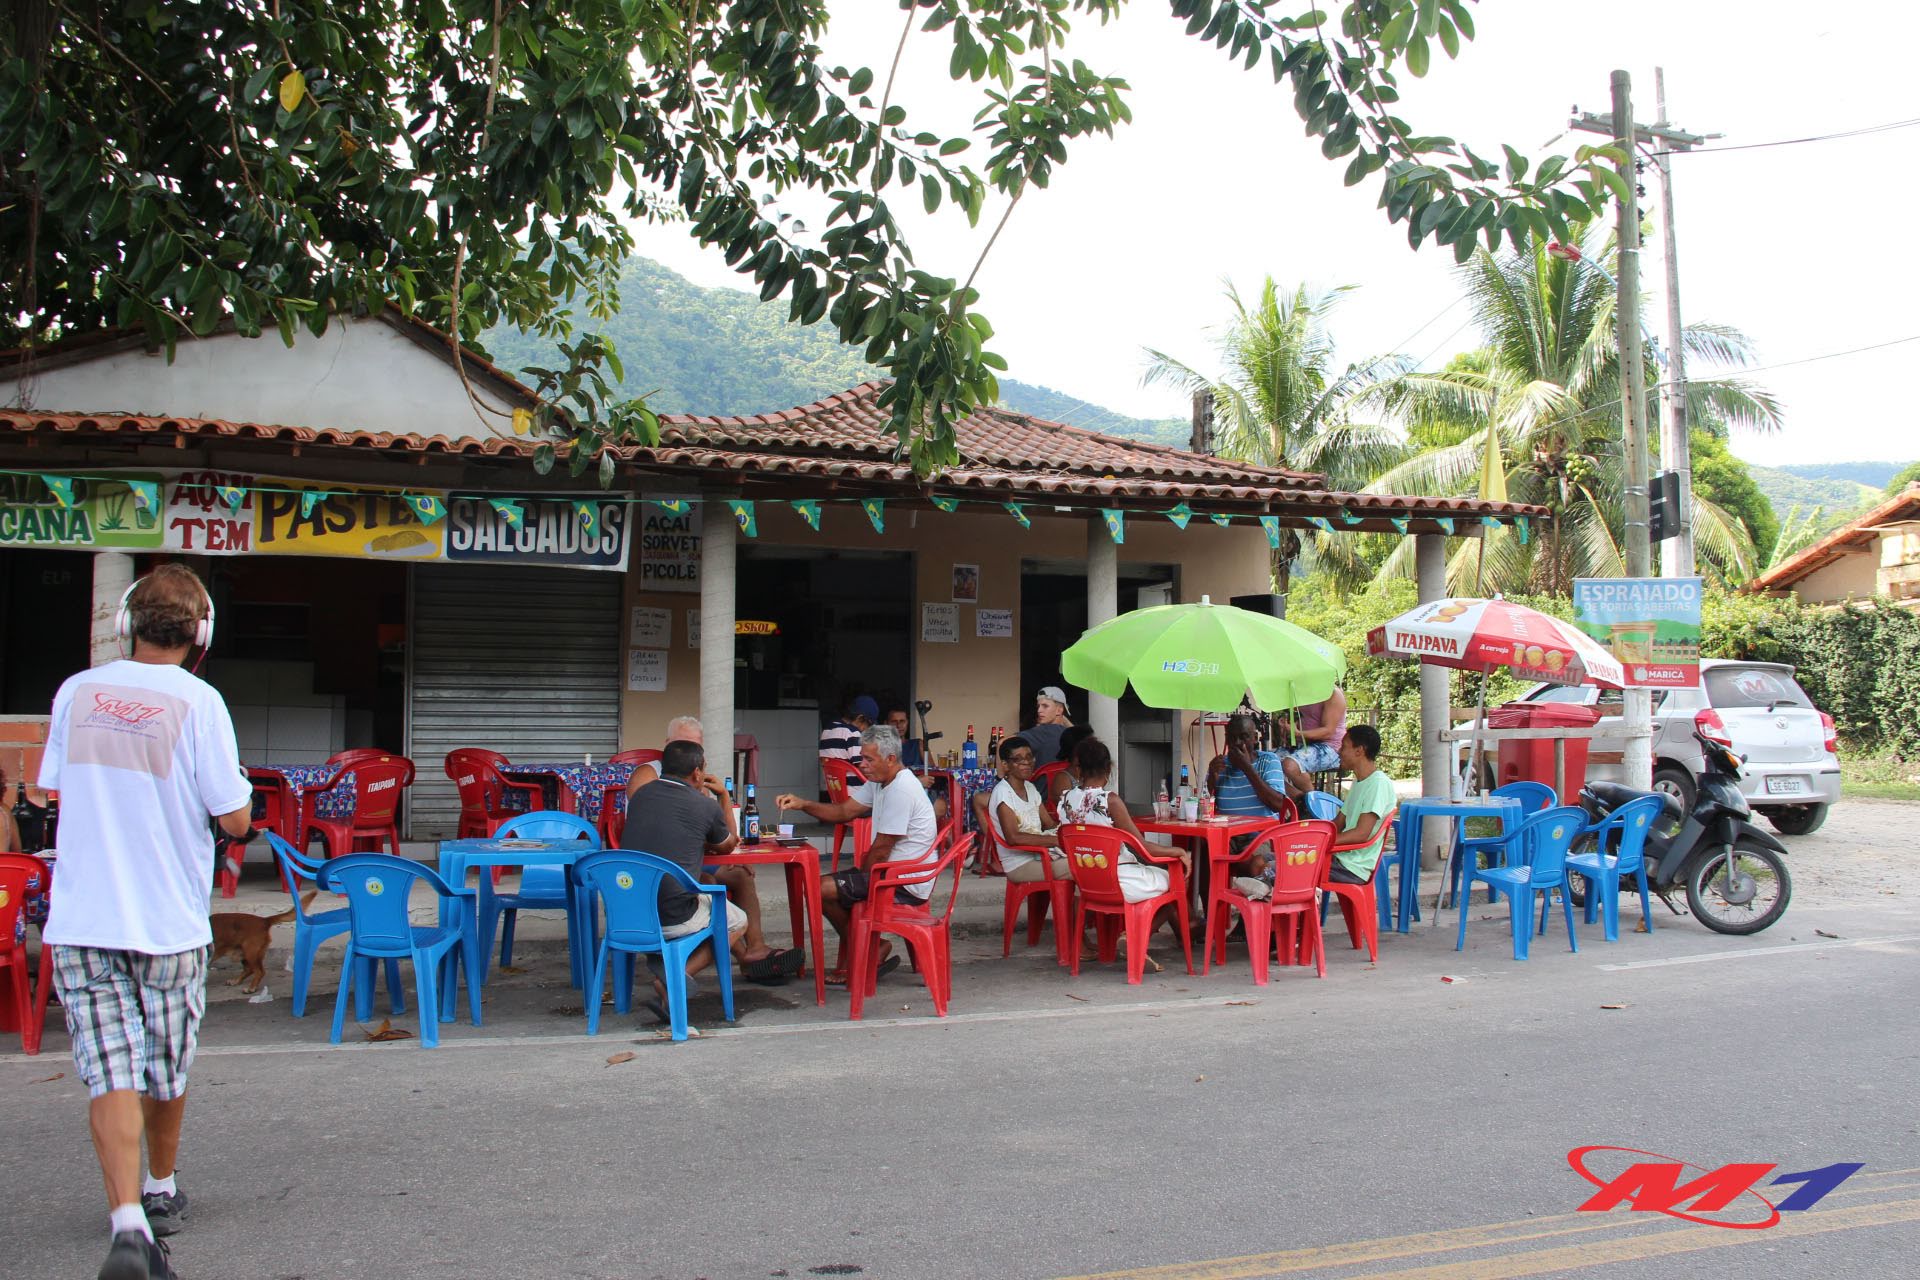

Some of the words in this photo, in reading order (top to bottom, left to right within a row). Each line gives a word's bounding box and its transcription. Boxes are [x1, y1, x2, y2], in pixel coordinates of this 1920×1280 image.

[259, 483, 425, 542] PASTE
[644, 513, 693, 533] AÇAÍ
[170, 518, 250, 551] TEM
[643, 561, 697, 580] PICOLÉ
[1581, 584, 1696, 601] ESPRAIADO
[1584, 602, 1598, 611] DE
[1600, 602, 1641, 612] PORTAS
[1645, 602, 1692, 611] ABERTAS
[743, 621, 772, 633] SKOL
[1395, 632, 1458, 655] ITAIPAVA
[367, 777, 396, 793] ITAIPAVA
